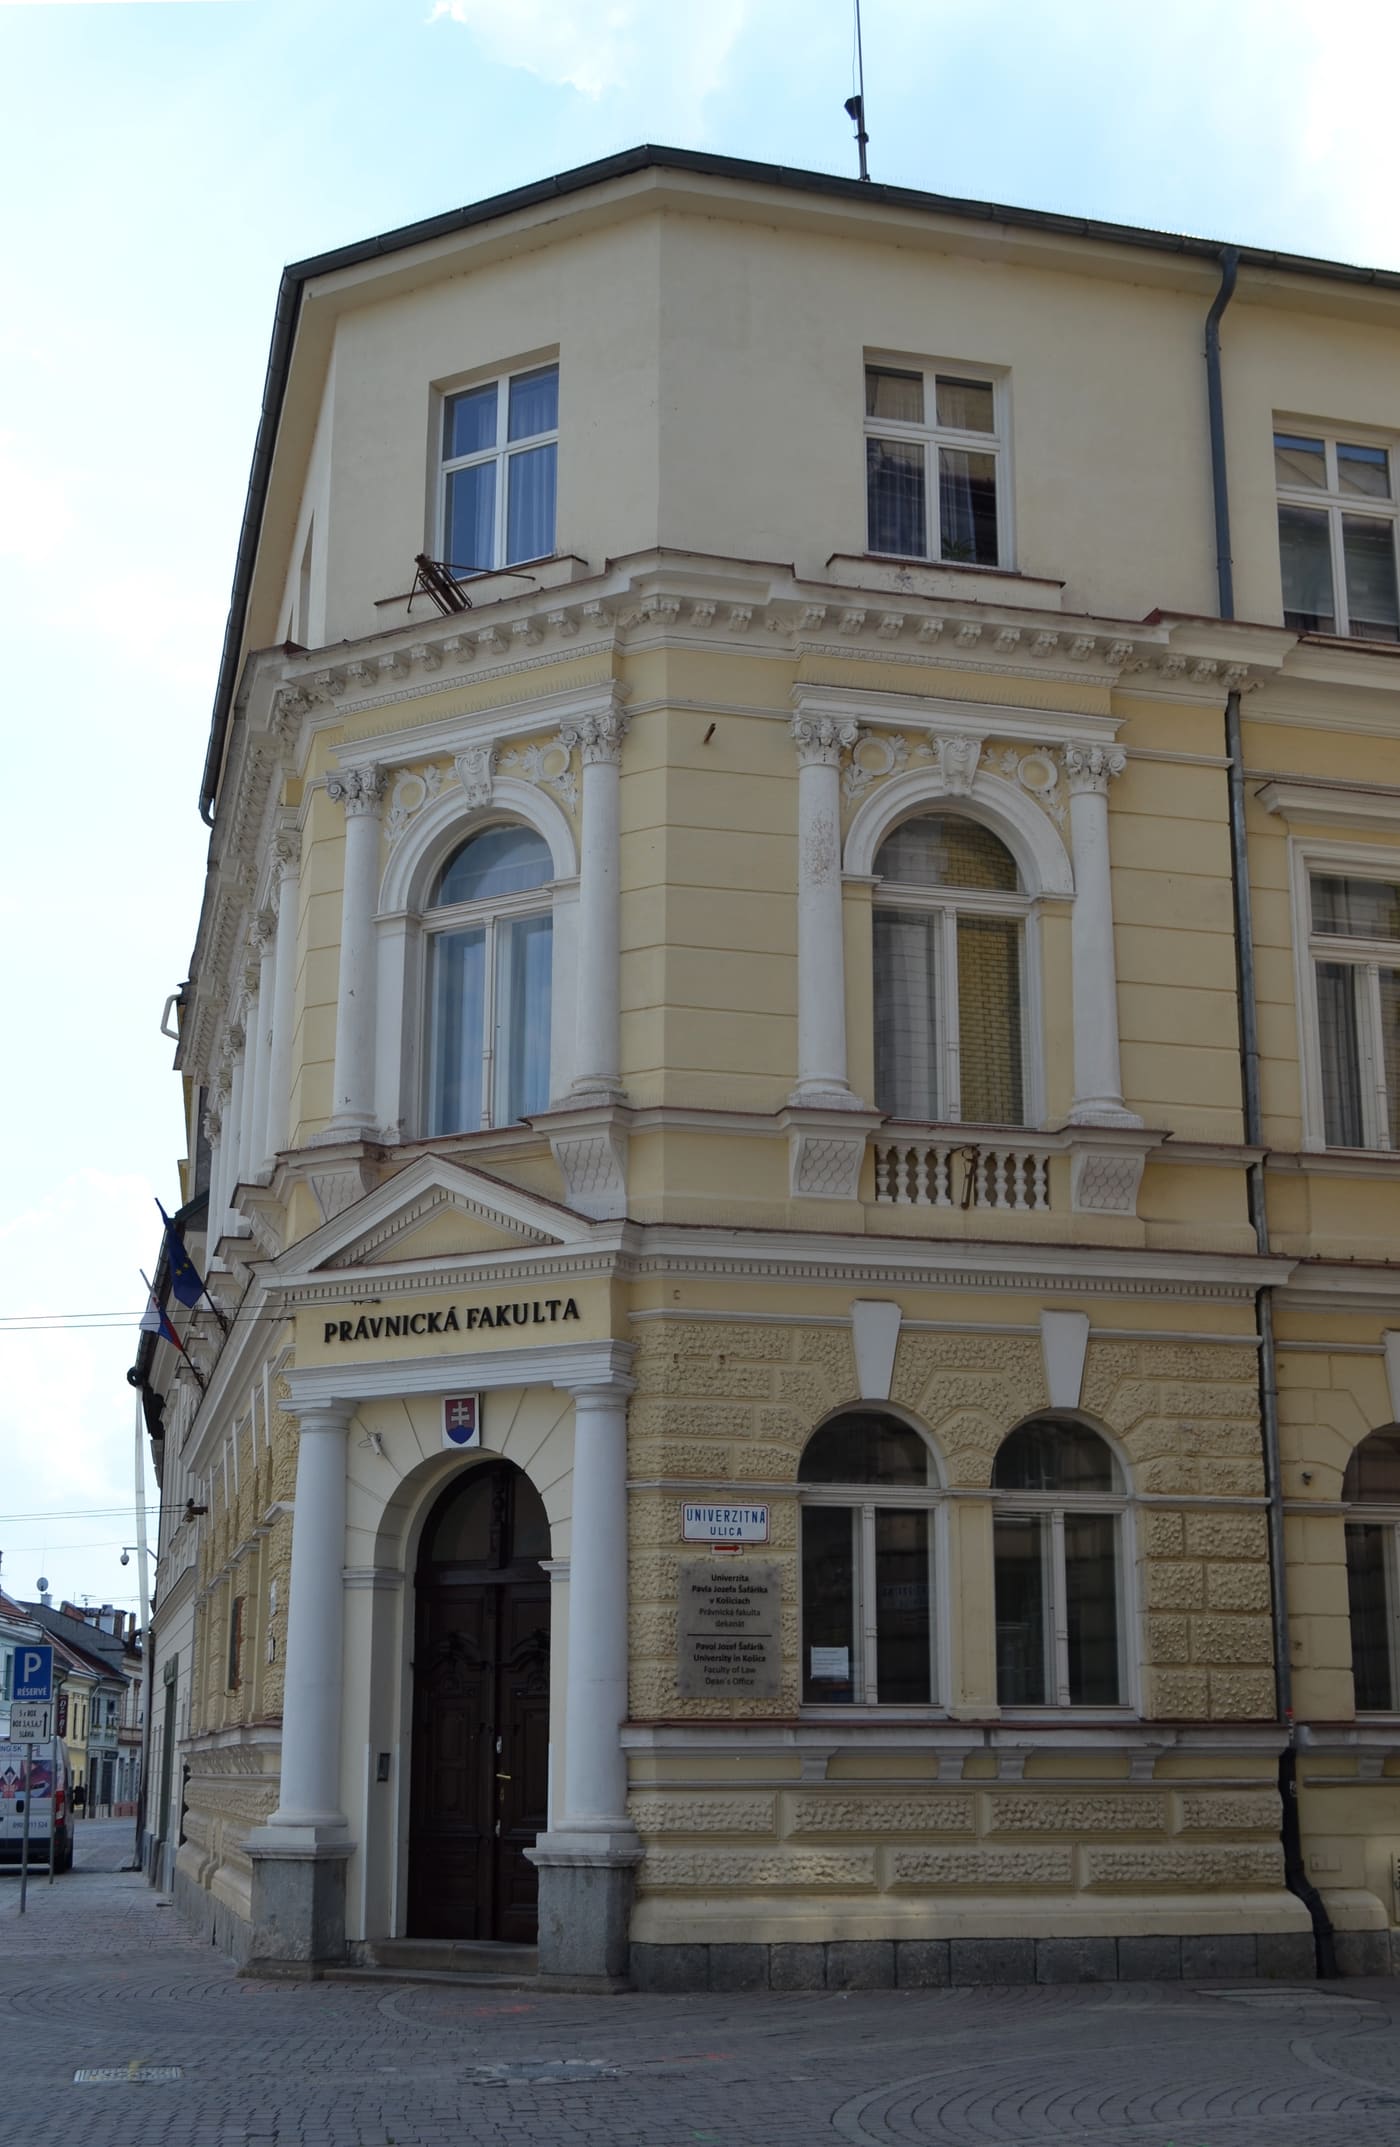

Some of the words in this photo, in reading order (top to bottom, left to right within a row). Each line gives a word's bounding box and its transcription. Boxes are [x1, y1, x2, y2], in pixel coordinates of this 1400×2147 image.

[324, 1306, 459, 1343] PRÁVNICKÁ
[466, 1298, 580, 1330] FAKULTA
[686, 1508, 765, 1524] UNIVERZITNÁ
[710, 1526, 742, 1537] ULICA
[711, 1573, 749, 1582] Univerzita
[692, 1584, 712, 1593] Pavla
[714, 1585, 736, 1593] Jozefa
[738, 1584, 768, 1594] Šafárika
[716, 1596, 751, 1605] Košiciach
[698, 1608, 734, 1616] Právnická
[736, 1608, 761, 1616] fakulta
[715, 1619, 745, 1628] dekanát
[695, 1642, 716, 1650] Pavol
[718, 1642, 737, 1650] Jozef
[738, 1641, 764, 1651] Šafárik
[693, 1654, 732, 1663] University
[733, 1654, 741, 1662] in
[742, 1654, 766, 1662] Košice
[24, 1652, 42, 1683] P
[703, 1666, 730, 1674] Faculty
[732, 1665, 740, 1673] of
[741, 1666, 756, 1674] Law
[732, 1677, 754, 1686] Office
[16, 1685, 47, 1697] RÉSERVÉ
